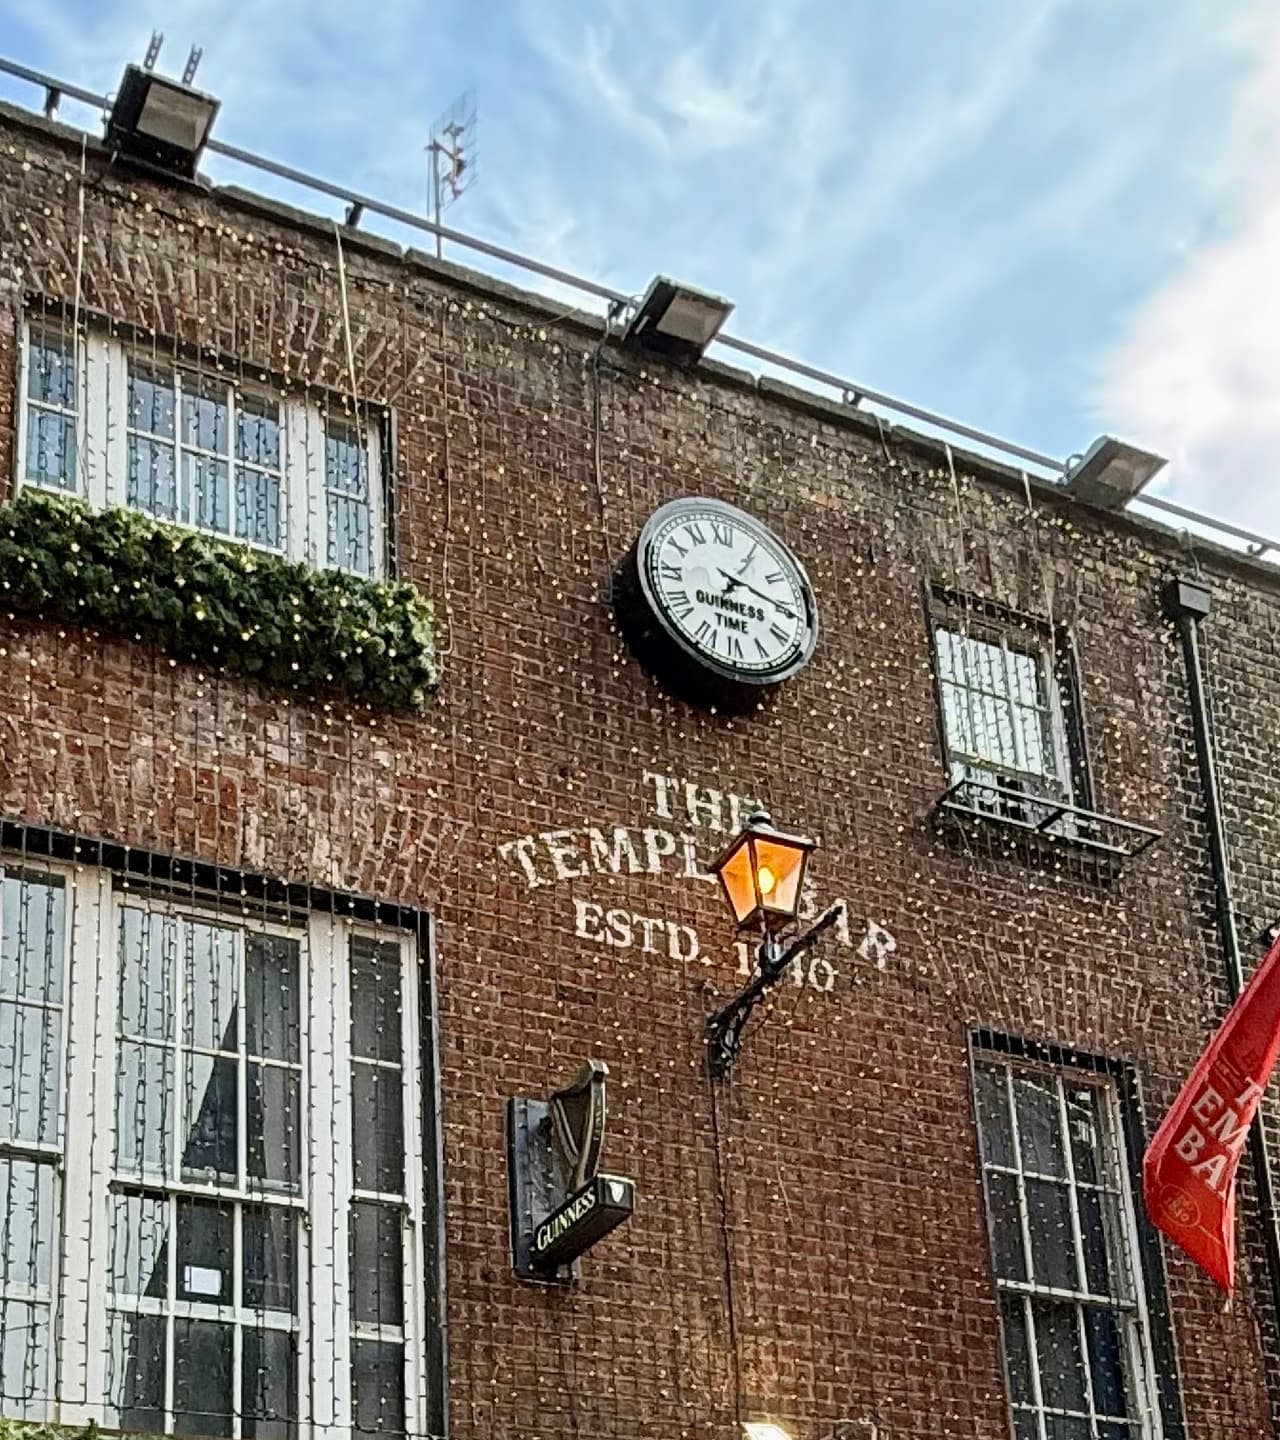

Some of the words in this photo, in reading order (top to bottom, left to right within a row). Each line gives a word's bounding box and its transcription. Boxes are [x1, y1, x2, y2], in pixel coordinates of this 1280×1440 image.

[696, 589, 765, 621] GUINNESS
[714, 612, 749, 634] TIME
[499, 825, 719, 889] TEMPL
[536, 1186, 596, 1251] GUINNESS
